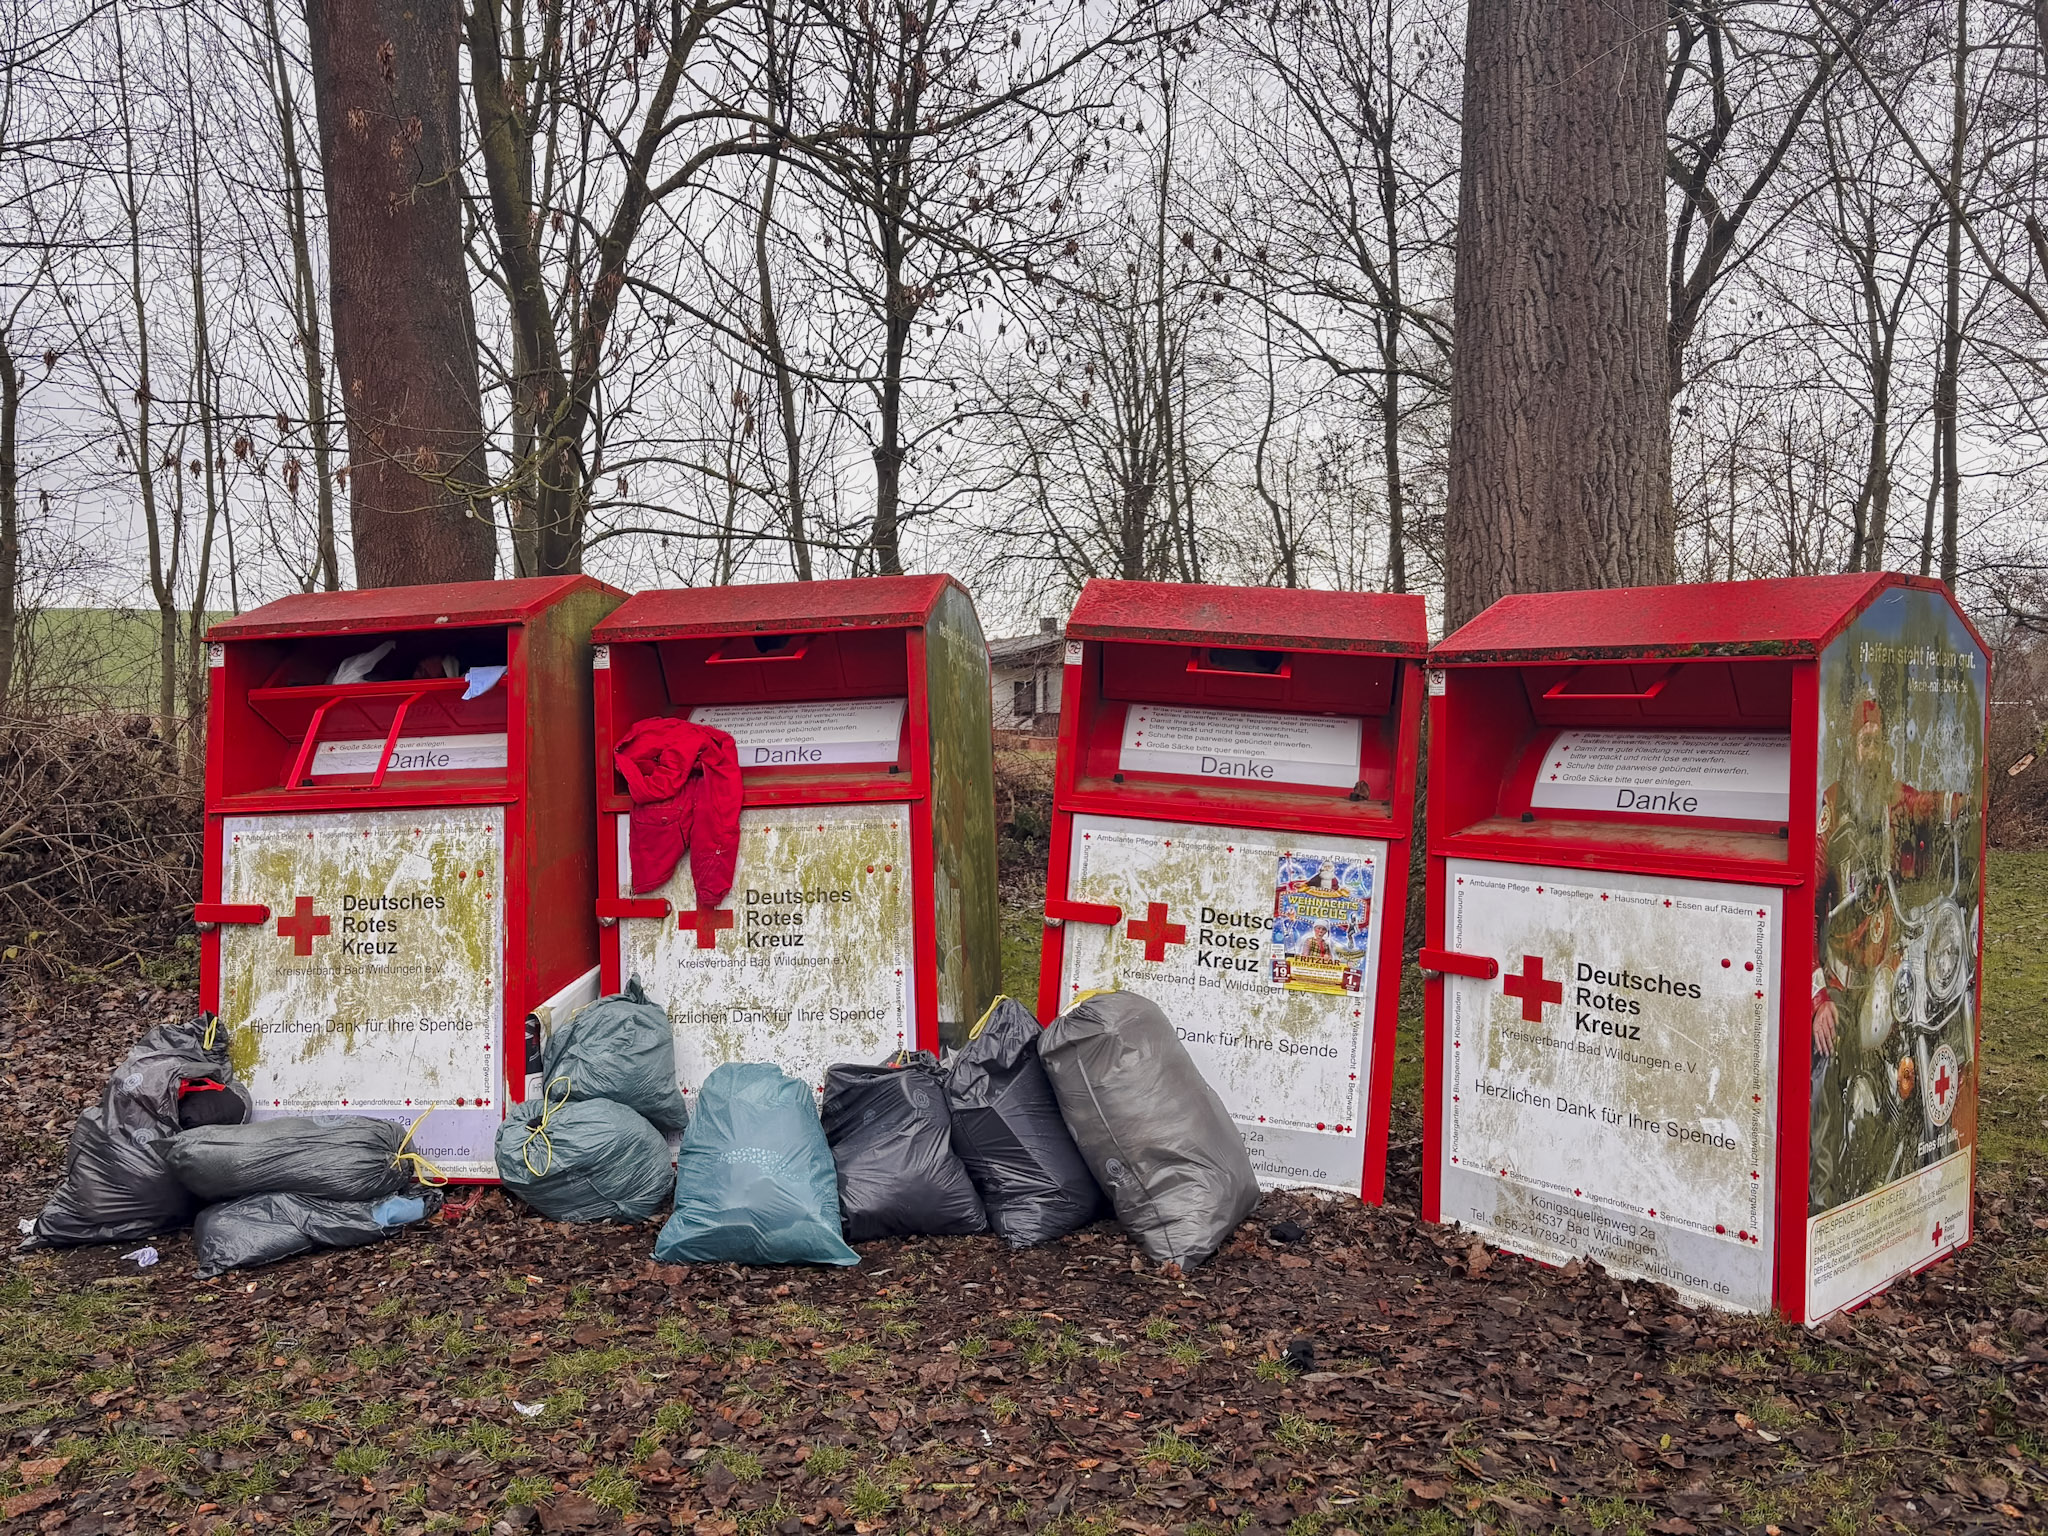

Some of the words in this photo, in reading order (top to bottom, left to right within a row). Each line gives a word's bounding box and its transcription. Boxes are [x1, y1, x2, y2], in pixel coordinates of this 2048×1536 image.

[1859, 641, 1894, 663] Helfen
[1897, 645, 1924, 665] steht
[1925, 645, 1956, 670] jedem
[1958, 651, 1976, 671] gut.
[1147, 730, 1177, 739] Schuhe
[1195, 735, 1233, 743] paarweise
[1234, 737, 1272, 746] gebündelt
[1273, 740, 1313, 749] einwerfen.
[755, 746, 822, 764] Danke
[1146, 741, 1170, 750] Große
[1171, 742, 1195, 751] Säcke
[1214, 747, 1232, 755] quer
[1233, 747, 1266, 757] einlegen.
[1570, 752, 1587, 760] bitte
[1588, 753, 1621, 761] verpackt
[1662, 755, 1680, 763] lose
[386, 751, 450, 770] Danke
[1201, 756, 1274, 778] Danke
[1566, 762, 1596, 770] Schuhe
[1597, 763, 1614, 771] bitte
[1615, 764, 1657, 773] paarweise
[1659, 764, 1702, 774] gebündelt
[1703, 766, 1749, 775] einwerfen.
[1562, 773, 1587, 782] Große
[1588, 774, 1613, 783] Säcke
[1614, 775, 1633, 784] bitte
[1634, 777, 1653, 786] quer
[1654, 777, 1694, 787] einlegen.
[1616, 789, 1698, 812] Danke
[1096, 834, 1134, 845] Ambulante
[1135, 837, 1159, 847] Pflege
[1239, 847, 1280, 857] Hausnotruf
[1079, 844, 1090, 898] Schulbetreuung
[1469, 878, 1506, 890] Ambulante
[1507, 882, 1531, 893] Pflege
[1549, 887, 1594, 899] Tagespflege
[343, 893, 445, 911] Deutsches
[746, 887, 852, 905] Deutsches
[1288, 894, 1358, 911] WEIHNACHTS
[1614, 893, 1658, 906] Hausnotruf
[1297, 905, 1348, 920] CIRCUS
[1676, 900, 1702, 911] Essen
[1704, 902, 1719, 913] auf
[1720, 903, 1753, 916] Rädern
[343, 916, 397, 933] Rotes
[746, 910, 803, 927] Rotes
[1201, 907, 1274, 930] Deutsc
[1456, 890, 1464, 949] Schulbetreuung
[342, 939, 398, 955] Kreuz
[746, 931, 804, 948] Kreuz
[1199, 929, 1260, 951] Rotes
[678, 957, 747, 969] Kreisverband
[750, 956, 770, 967] Bad
[774, 955, 830, 968] Wildungen
[1197, 950, 1259, 973] Kreuz
[1294, 955, 1341, 966] FRITZLAR
[1755, 920, 1765, 986] Rettungsdienst
[275, 966, 341, 977] Kreisverband
[345, 965, 364, 975] Bad
[367, 964, 422, 977] Wildungen
[1273, 966, 1291, 977] 19.
[1122, 968, 1196, 987] Kreisverband
[1199, 976, 1221, 989] Bad
[1225, 978, 1285, 997] Wildungen
[1346, 975, 1357, 986] 1.
[1577, 962, 1701, 999] Deutsches
[1576, 987, 1640, 1015] Rotes
[667, 1010, 727, 1024] erzlichen
[733, 1009, 769, 1023] Dank
[773, 1008, 793, 1022] für
[797, 1008, 824, 1021] Ihre
[829, 1007, 885, 1023] Spende
[1453, 991, 1461, 1039] Kleiderladen
[250, 1019, 321, 1034] Herzlichen
[325, 1019, 361, 1033] Dank
[365, 1018, 385, 1032] für
[388, 1018, 414, 1032] Ihre
[419, 1018, 473, 1034] Spende
[1575, 1011, 1641, 1041] Kreuz
[1176, 1027, 1215, 1045] Dank
[1219, 1032, 1239, 1047] für
[1244, 1035, 1273, 1051] Ihre
[1278, 1039, 1338, 1058] Spende
[1350, 1021, 1360, 1069] Wasserwacht
[1501, 1028, 1574, 1051] Kreisverband
[1578, 1041, 1601, 1056] Bad
[1605, 1046, 1670, 1069] Wildungen
[1674, 1061, 1699, 1075] e.V.
[1752, 1003, 1763, 1089] Sanitätsbereitschaft
[483, 1053, 491, 1094] Bergwacht
[1453, 1051, 1461, 1093] Blutspende
[282, 1099, 340, 1107] Betreuungsverein
[351, 1099, 402, 1107] Jugendrotkreuz
[1345, 1083, 1355, 1121] Bergwacht
[398, 1116, 411, 1126] 2a
[1474, 1079, 1551, 1109] Herzlichen
[1556, 1097, 1597, 1120] Dank
[1601, 1107, 1623, 1125] für
[1629, 1112, 1661, 1134] Ihre
[1666, 1121, 1736, 1150] Spende
[1250, 1131, 1264, 1142] 2a
[1452, 1104, 1460, 1153] Kindergarten
[1750, 1108, 1760, 1167] Wasserwacht
[1917, 1138, 1937, 1157] Eines
[1937, 1133, 1947, 1149] für
[1947, 1128, 1959, 1144] alle
[1252, 1161, 1327, 1179] wildungen.de
[1462, 1157, 1480, 1169] Erste
[1510, 1170, 1573, 1194] Betreuungsverein
[1584, 1191, 1644, 1214] Jugendrotkreuz
[1749, 1182, 1759, 1229] Bergwacht
[1531, 1194, 1636, 1236] Königsquellenweg
[1640, 1225, 1656, 1240] 2a
[1815, 1224, 1830, 1240] IHRE
[1830, 1211, 1855, 1233] SPENDE
[1856, 1203, 1872, 1220] HILFT
[1873, 1197, 1885, 1212] UNS
[1886, 1189, 1907, 1207] HELFEN
[1944, 1209, 1964, 1225] Deutsches
[1528, 1210, 1563, 1228] 34537
[1567, 1220, 1590, 1237] Bad
[1593, 1227, 1657, 1257] Wildungen
[1504, 1218, 1518, 1231] 56
[1521, 1222, 1578, 1249] 21/7892-0
[1588, 1244, 1730, 1295] www.drk-wildungen.de
[1512, 1241, 1550, 1259] Deutschen
